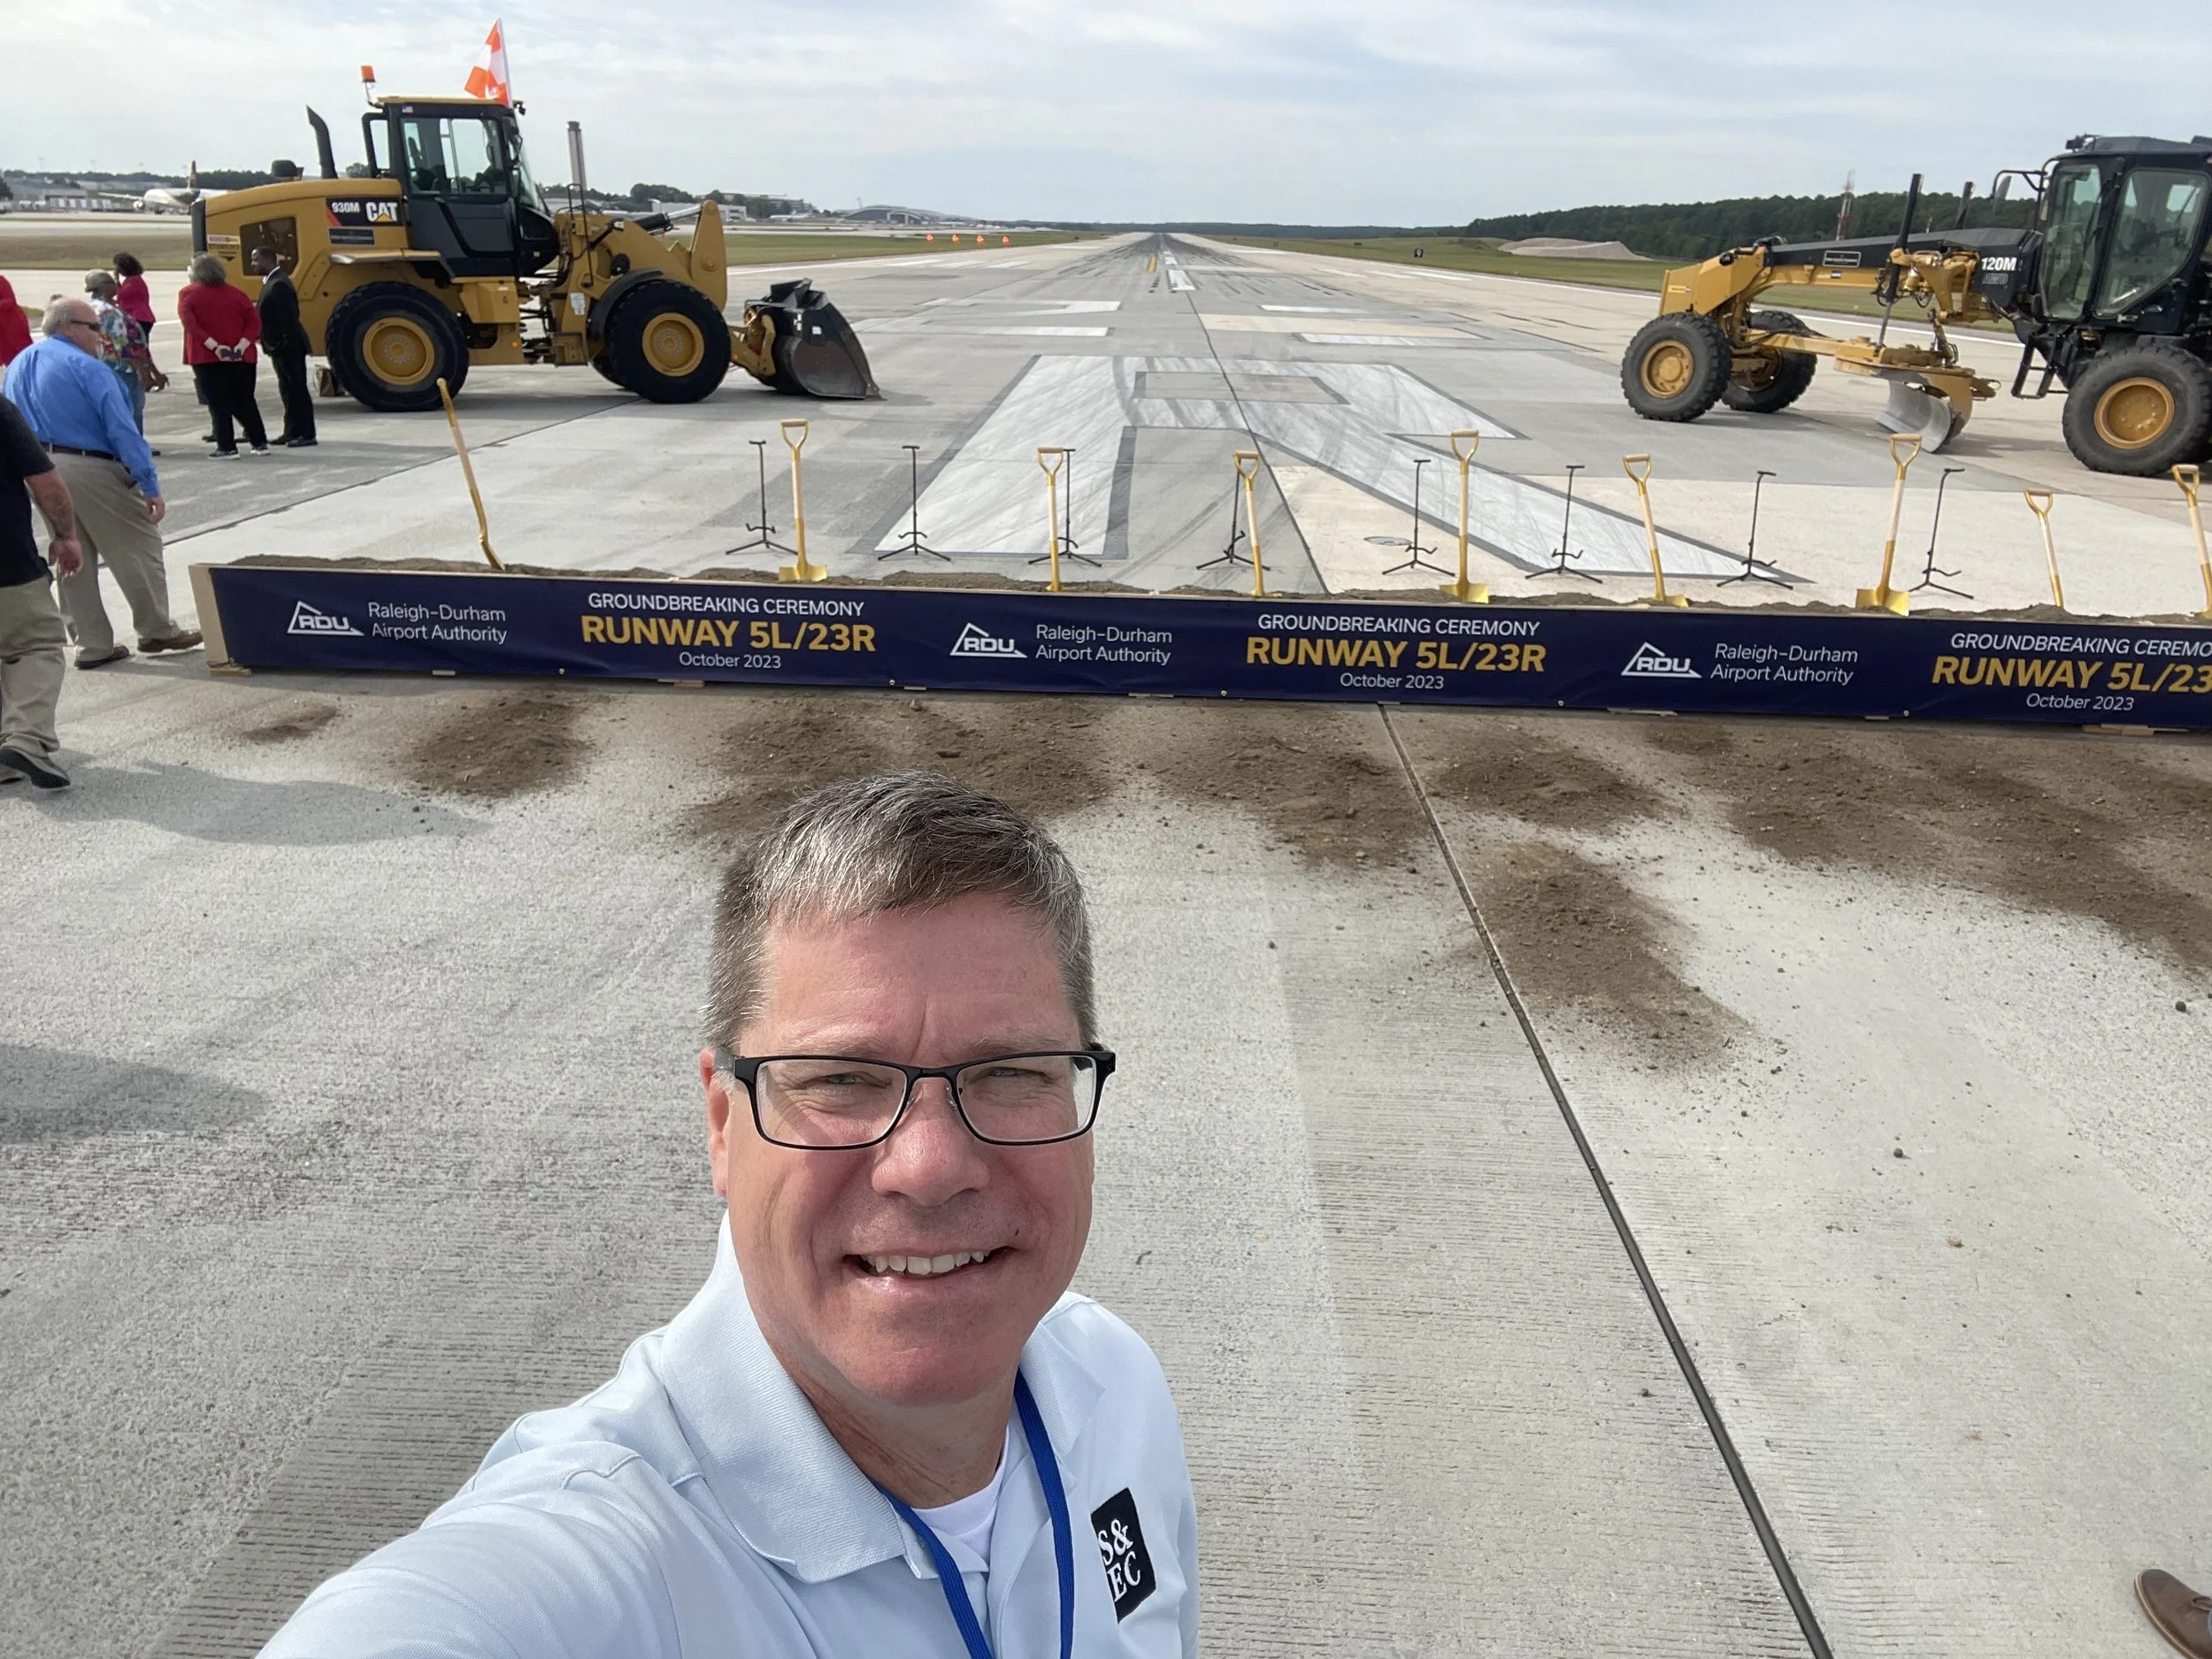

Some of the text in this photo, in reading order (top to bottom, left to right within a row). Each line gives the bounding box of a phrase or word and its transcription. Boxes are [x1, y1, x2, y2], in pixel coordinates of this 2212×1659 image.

[332, 202, 360, 213] 930M
[365, 201, 398, 222] CAT
[1981, 257, 2017, 271] 120M
[368, 602, 506, 622] Raleigh-Durham
[588, 593, 864, 617] GROUNDBREAKING CEREMONY
[372, 623, 508, 645] Airport Authority
[581, 615, 877, 652] RUNWAY 5L/23R
[1035, 625, 1172, 644] Raleigh-Durham
[1257, 614, 1540, 636] GROUNDBREAKING CEREMONY
[1035, 644, 1171, 666] Airport Authority
[1246, 636, 1547, 672] RUNWAY 5L/23R
[1715, 643, 1858, 664] Raleigh-Durham
[1950, 633, 2212, 657] GROUNDBREAKING CEREMO
[679, 651, 781, 669] October 2023
[1340, 672, 1445, 690] October 2023
[1710, 664, 1854, 686] Airport Authority
[1932, 656, 2104, 688] RUNWAY
[2026, 693, 2134, 711] October 2023
[1097, 1518, 1133, 1566] S&
[1106, 1550, 1141, 1602] EC
